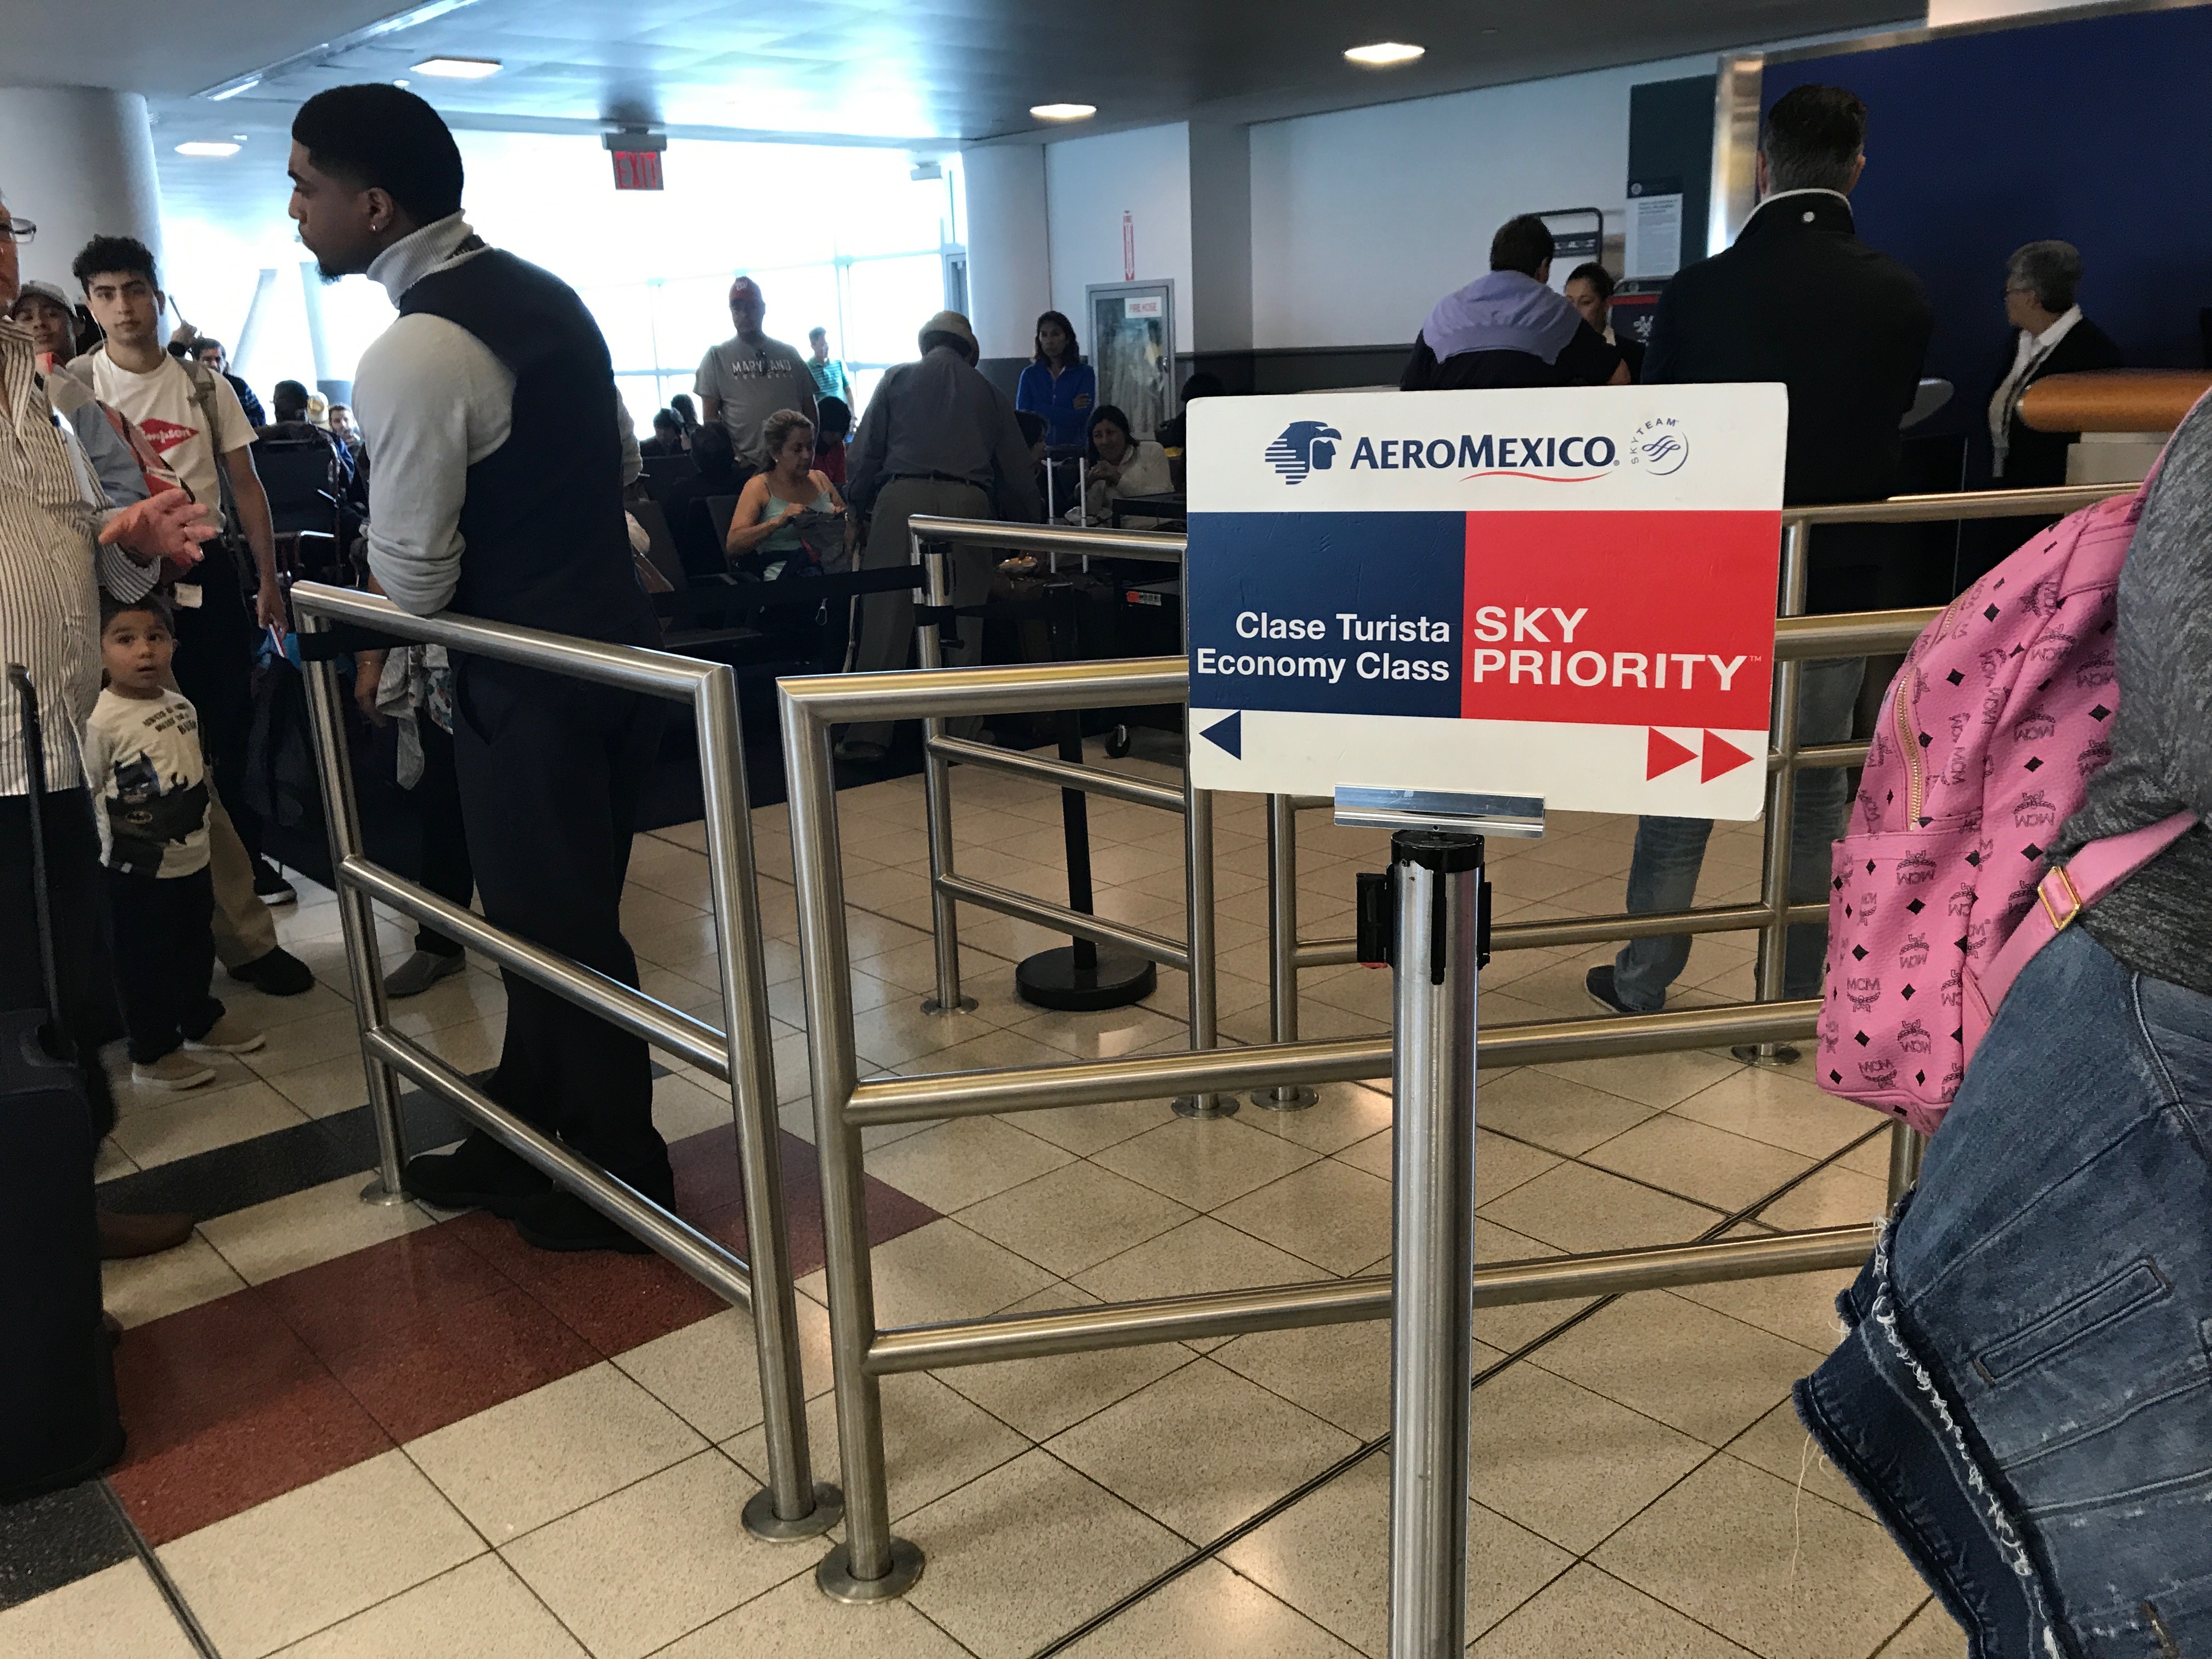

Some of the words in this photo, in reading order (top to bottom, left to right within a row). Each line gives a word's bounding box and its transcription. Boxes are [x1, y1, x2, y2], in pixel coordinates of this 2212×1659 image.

[615, 151, 657, 189] EXIT
[731, 359, 792, 373] MARYAND
[1630, 417, 1677, 465] SKYTEAM
[1350, 435, 1616, 469] AEROMEXICO
[1237, 612, 1325, 639] Clase
[1336, 614, 1449, 642] Turista
[1474, 606, 1588, 642] SKY
[1198, 648, 1346, 683] Economy
[1357, 652, 1449, 680] Class
[1474, 649, 1747, 691] PRIORITY
[1981, 687, 2001, 724] MCM
[2014, 725, 2055, 742] MCM
[1951, 747, 1967, 785] MCM
[2015, 812, 2055, 828] MCM
[1897, 870, 1936, 885] MCM
[1948, 903, 1972, 916] CM
[1900, 952, 1927, 969] MCM
[1847, 978, 1880, 991] MCM
[1941, 991, 1962, 1007] CM
[1899, 1040, 1932, 1054] MCM
[1858, 1058, 1894, 1073] MCM
